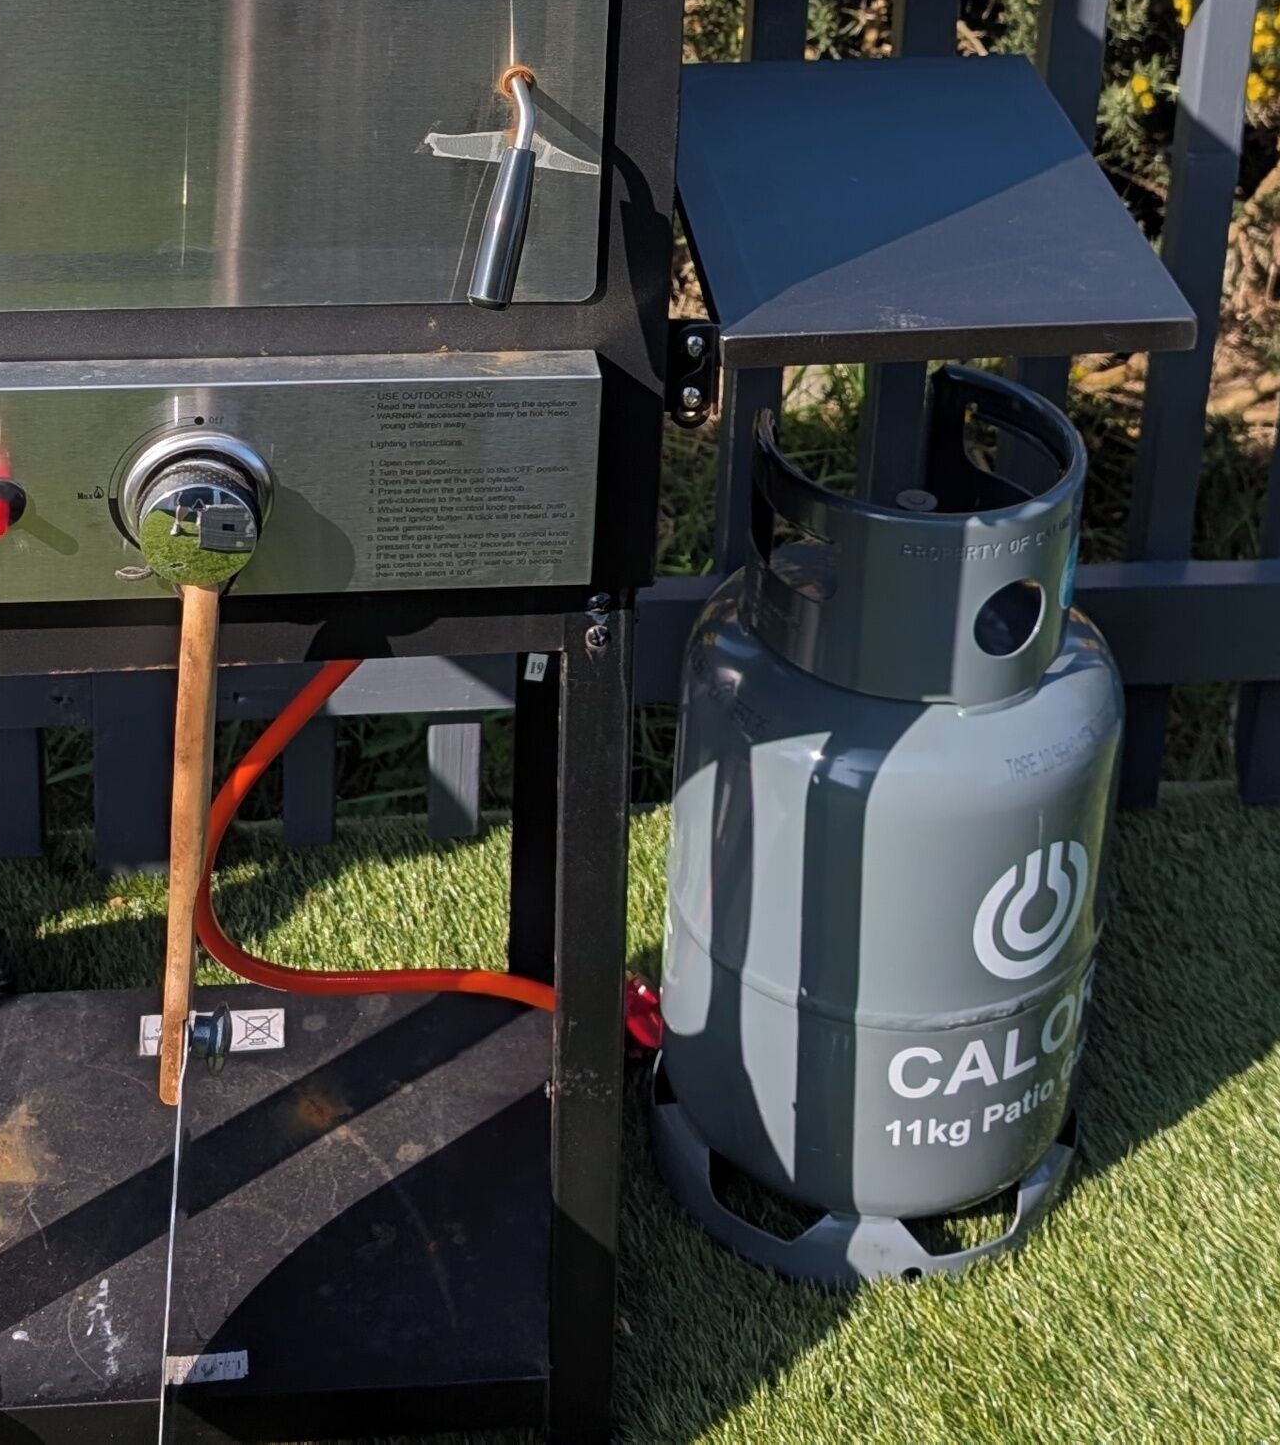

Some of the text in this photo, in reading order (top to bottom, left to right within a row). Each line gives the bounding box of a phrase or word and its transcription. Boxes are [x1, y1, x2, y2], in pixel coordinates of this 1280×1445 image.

[377, 390, 493, 400] USE OUTDOORS ONLY
[208, 416, 224, 425] Off
[370, 440, 407, 449] Lighting
[1009, 535, 1029, 555] OF
[885, 1078, 1055, 1147] 11kg Patio
